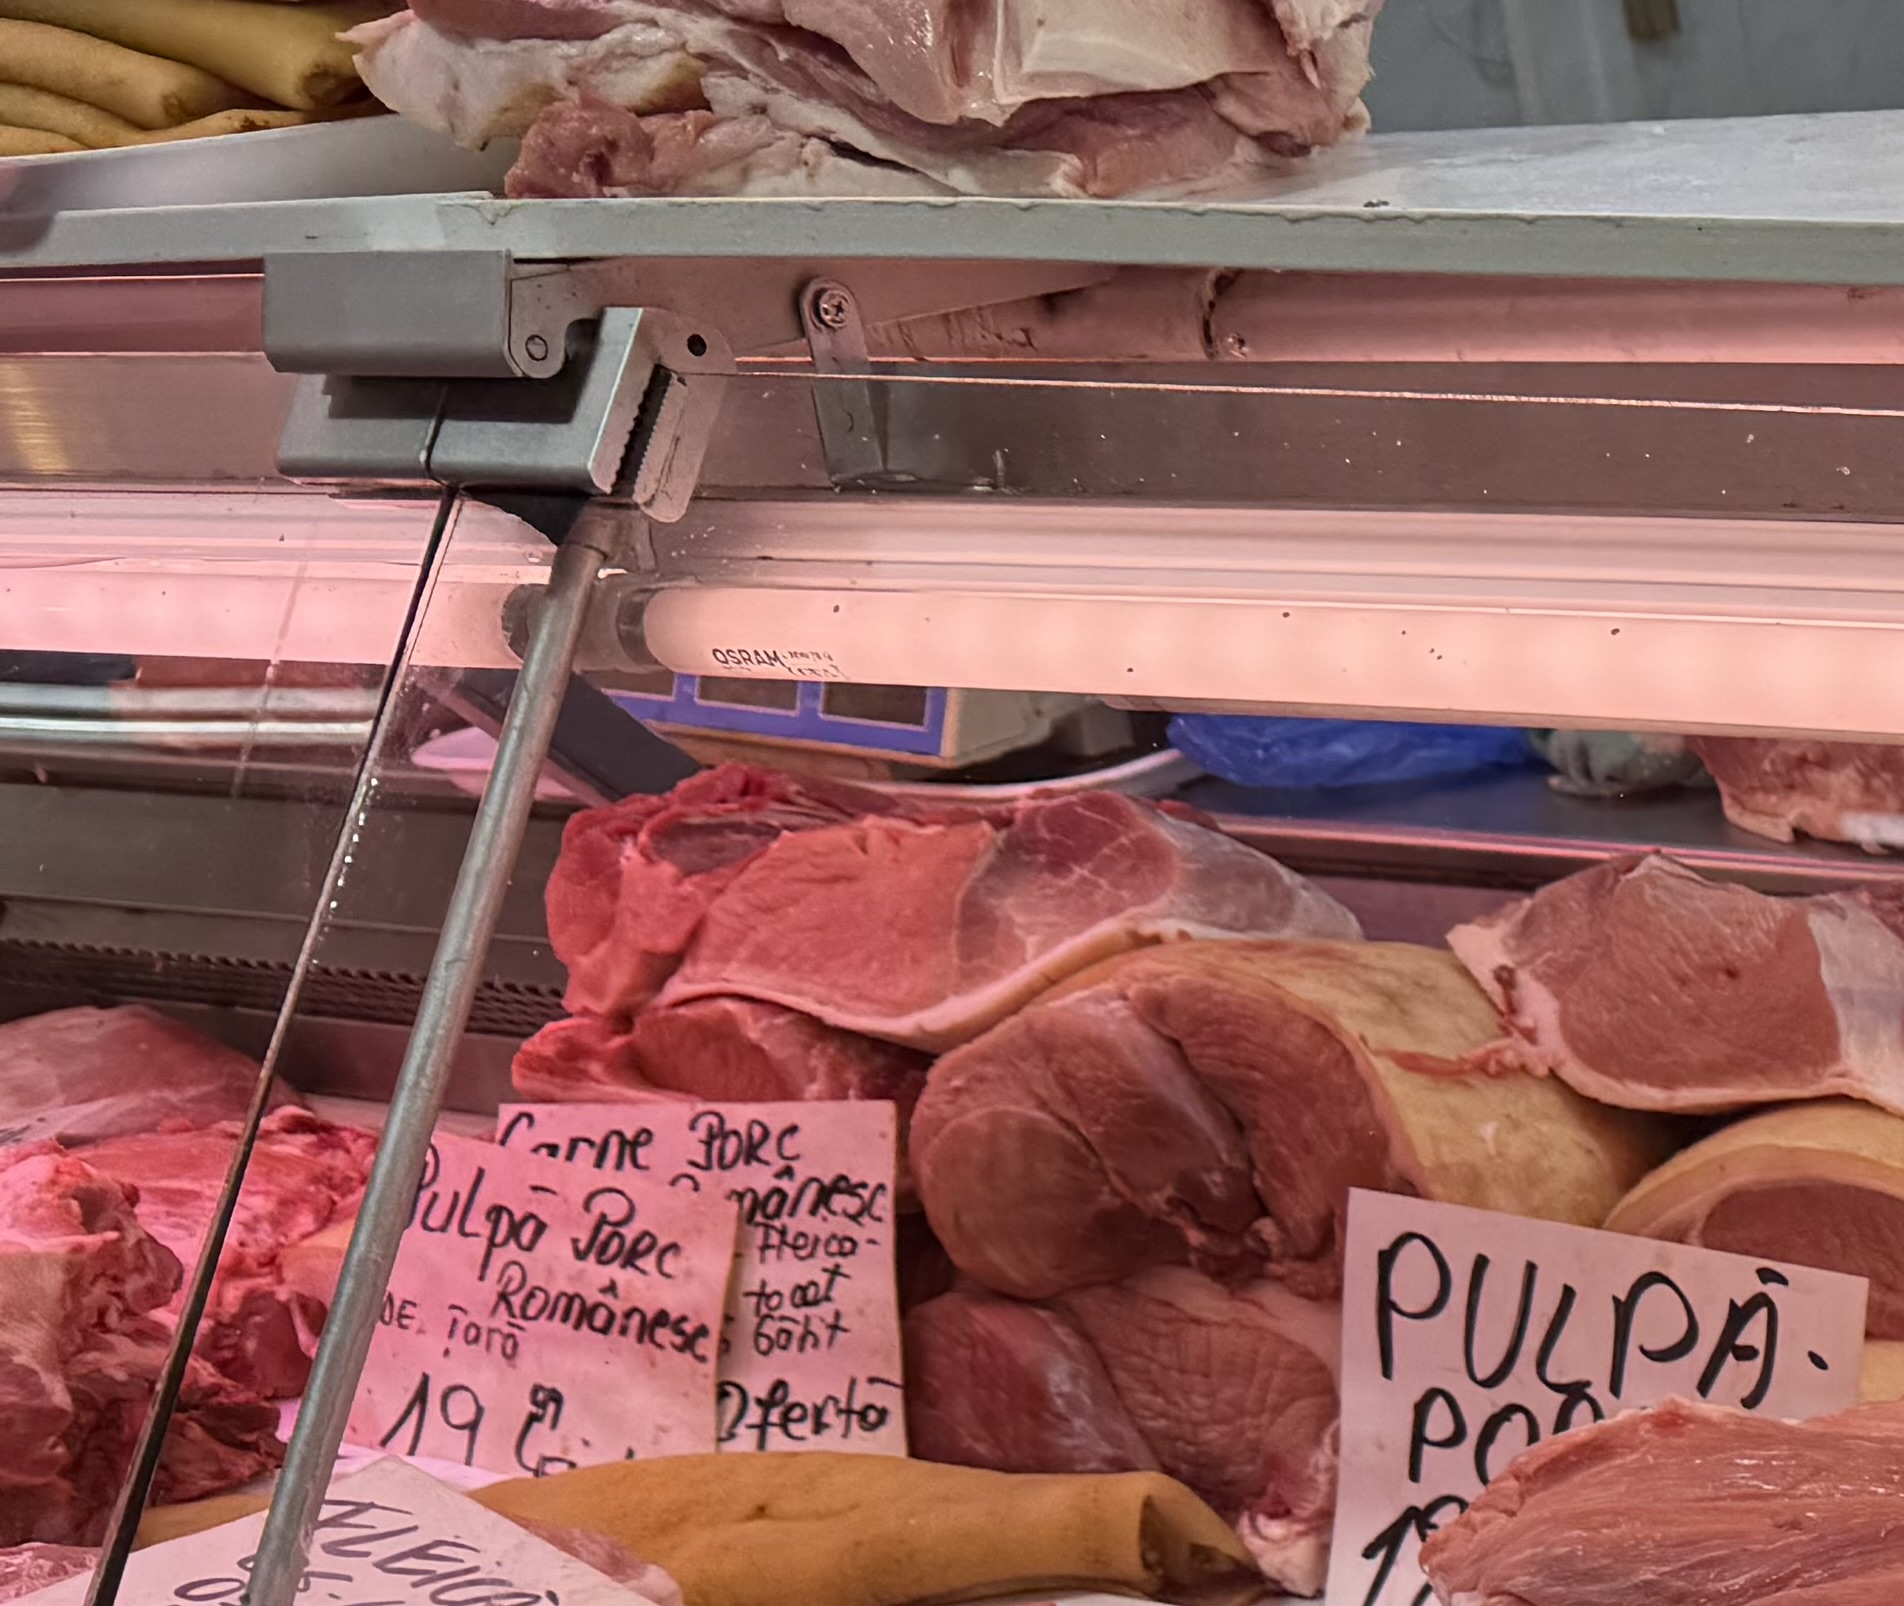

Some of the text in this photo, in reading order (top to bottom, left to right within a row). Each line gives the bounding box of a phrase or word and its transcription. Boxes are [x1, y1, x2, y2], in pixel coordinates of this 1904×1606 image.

[711, 648, 788, 668] OSRAM
[379, 1371, 486, 1468] 19
[1408, 1387, 1606, 1487] PO
